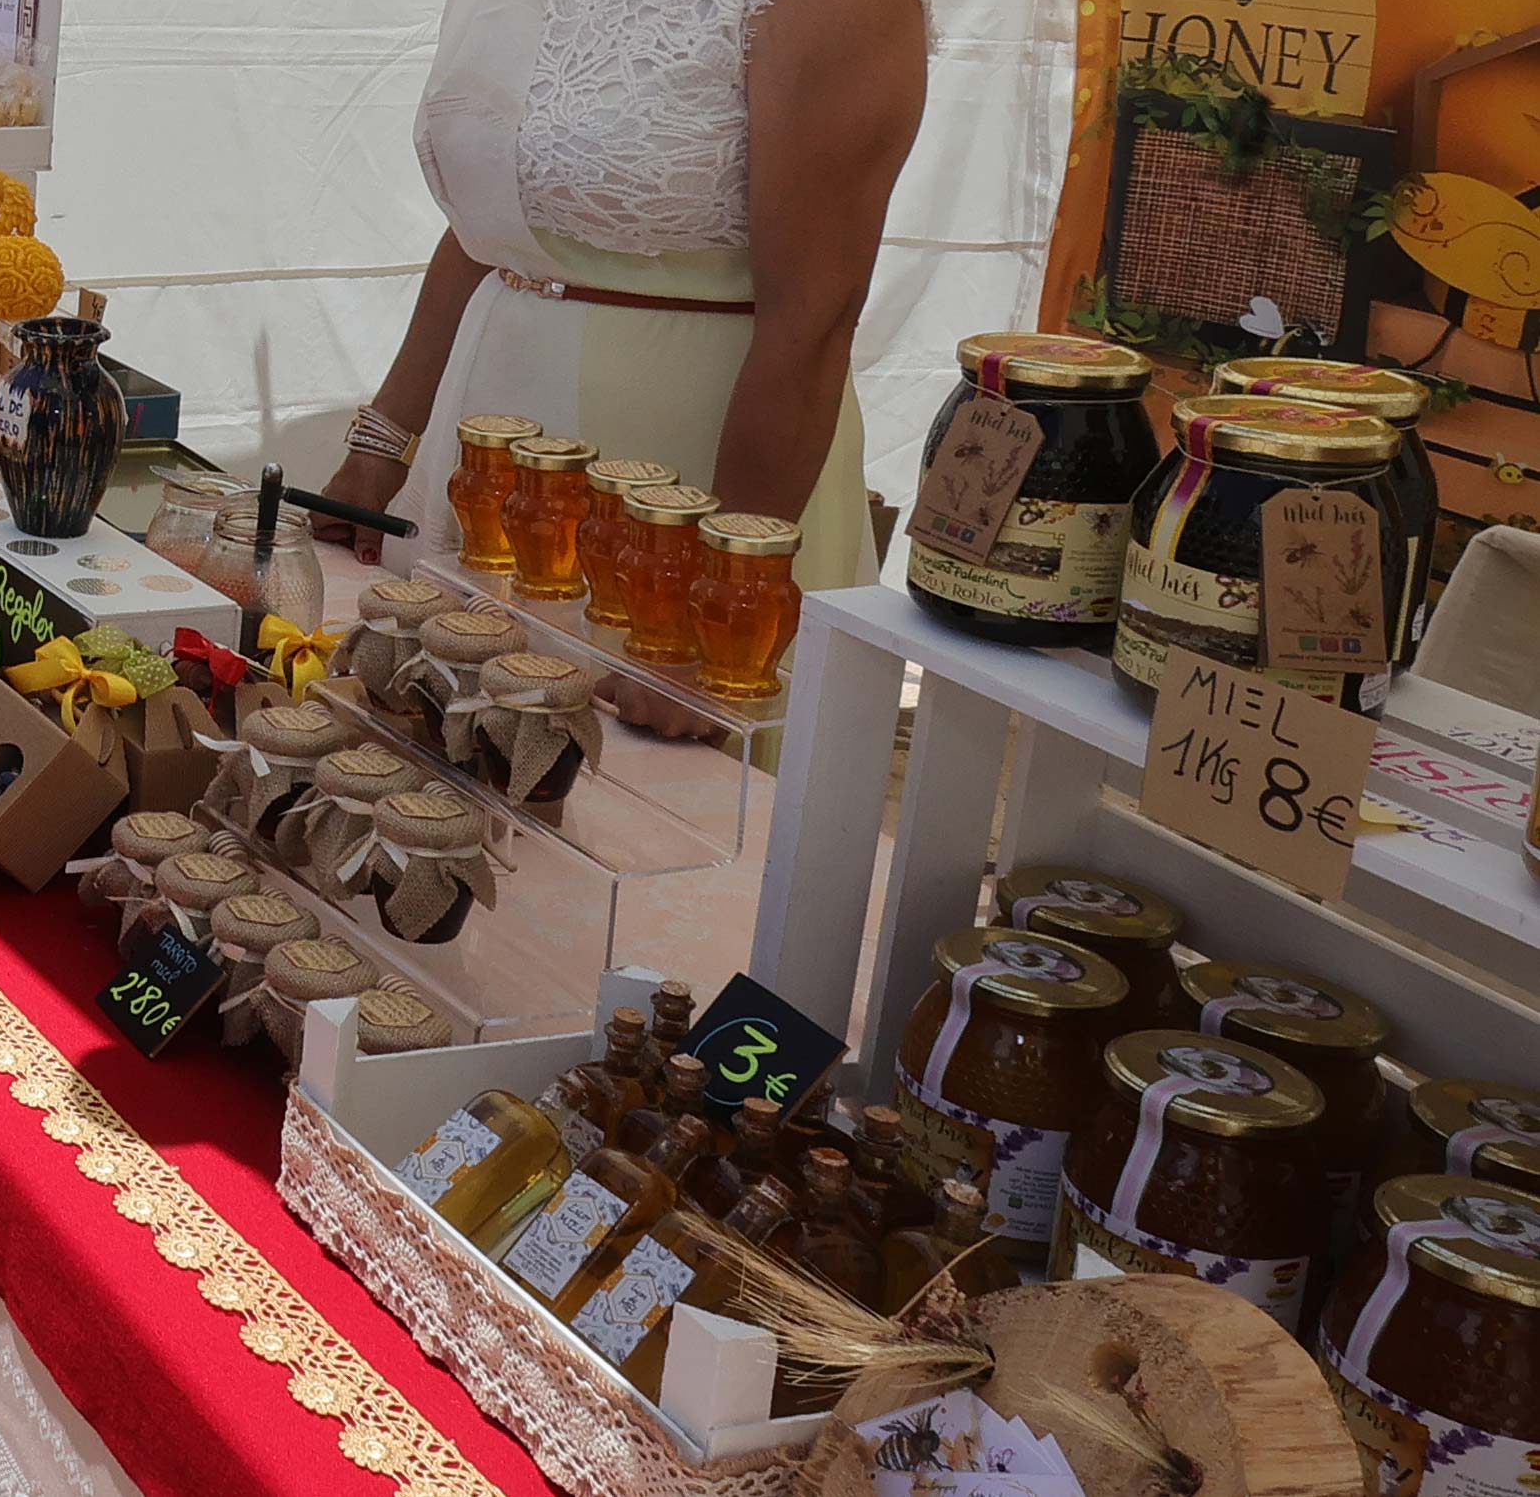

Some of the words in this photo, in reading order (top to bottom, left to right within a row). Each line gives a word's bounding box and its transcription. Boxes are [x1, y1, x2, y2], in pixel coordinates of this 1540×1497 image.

[1120, 9, 1360, 94] HONEY
[9, 399, 23, 417] DE
[1180, 665, 1299, 750] MIEL
